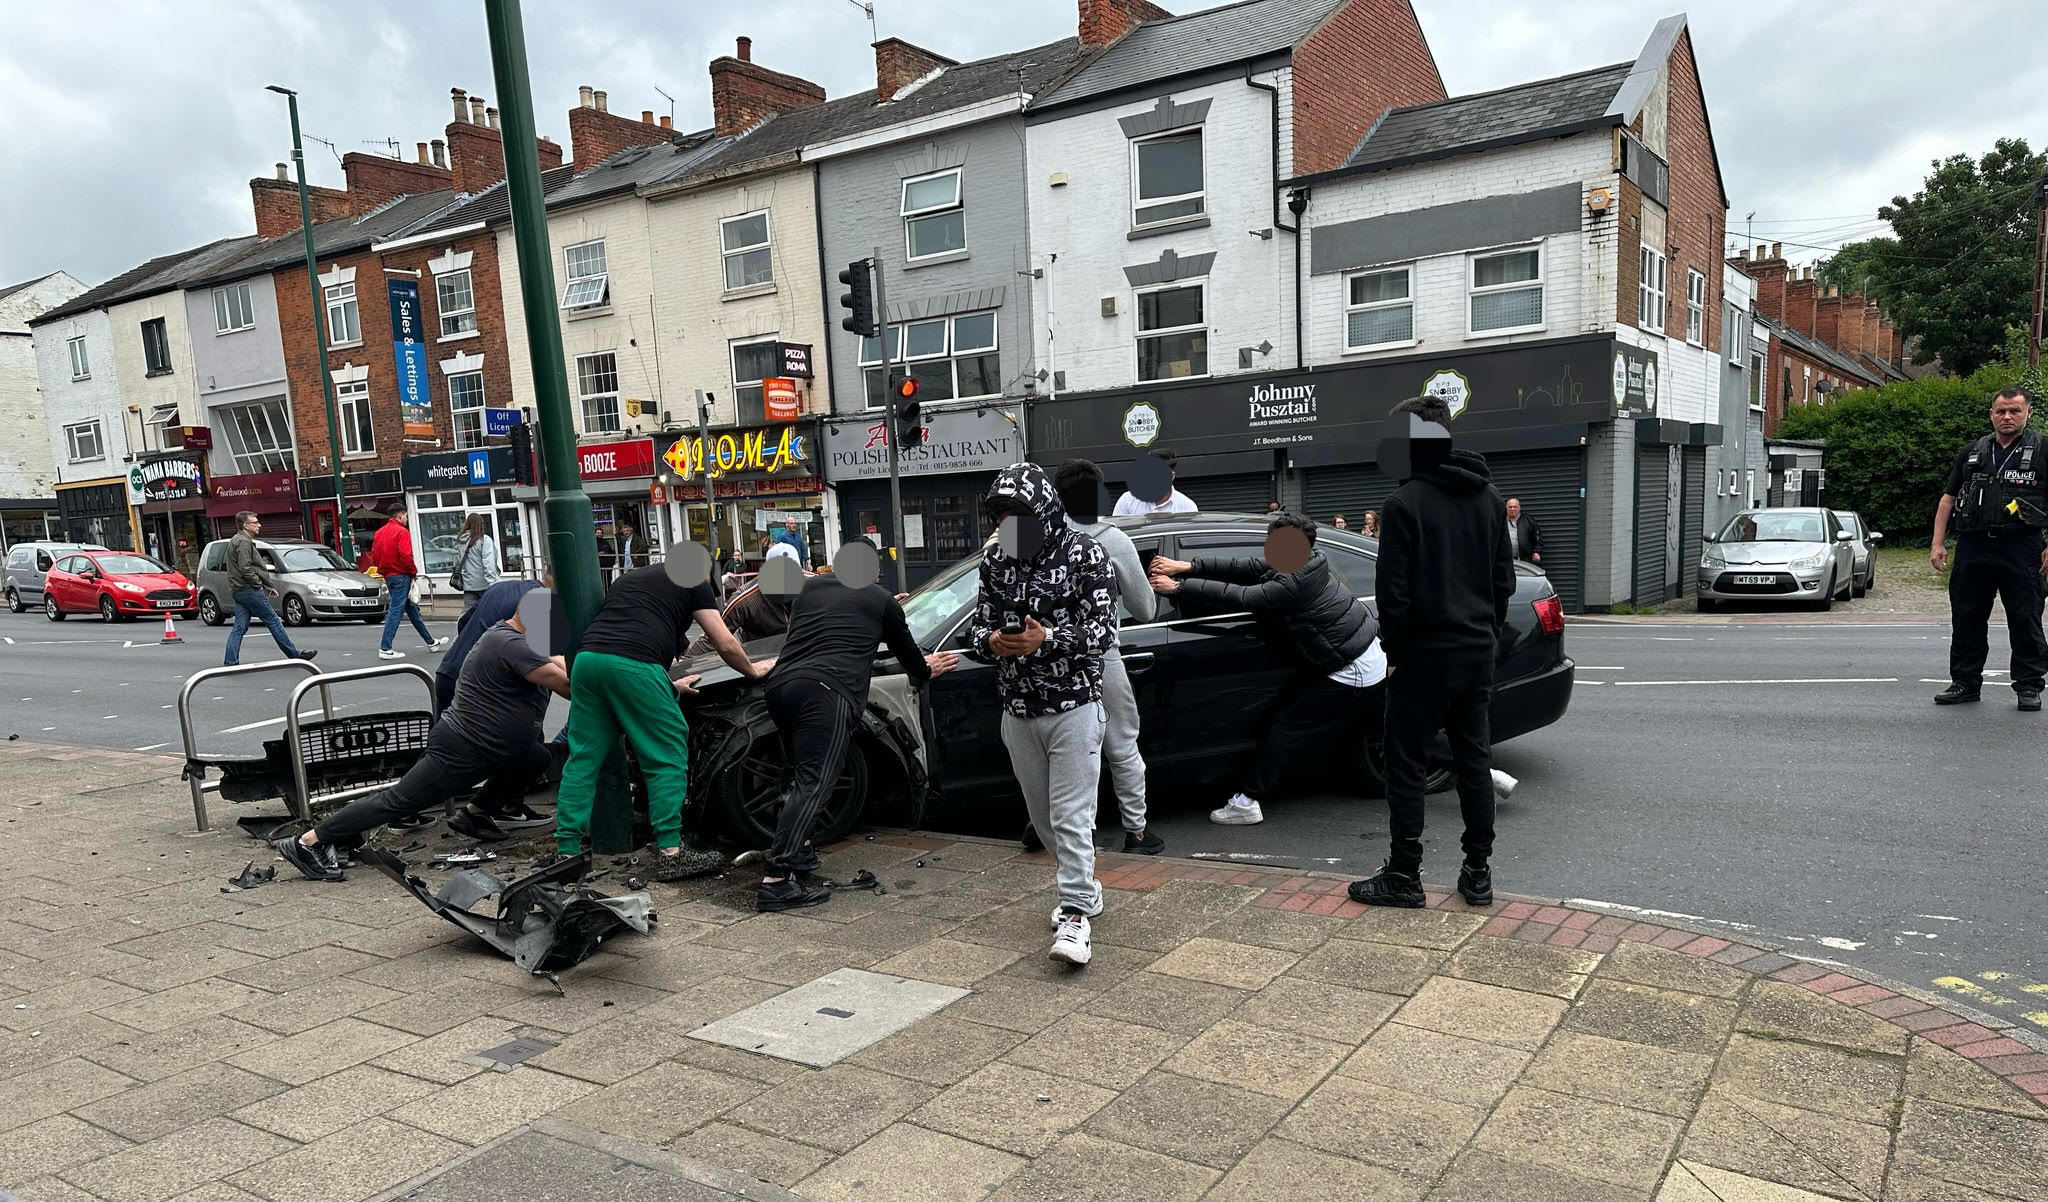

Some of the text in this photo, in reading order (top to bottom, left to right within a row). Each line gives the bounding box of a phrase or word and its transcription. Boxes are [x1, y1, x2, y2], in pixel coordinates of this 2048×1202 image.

[400, 301, 412, 334] Sales
[404, 337, 414, 347] &
[785, 348, 806, 359] PIZZA
[786, 361, 807, 372] ROMA
[405, 351, 419, 401] Lettings
[1249, 383, 1316, 403] Johnny
[1249, 401, 1310, 419] Pusztai
[496, 412, 509, 421] Off
[1128, 418, 1153, 426] SNOBBY
[1293, 415, 1318, 423] BUTCHER
[489, 423, 513, 431] Licen
[1127, 425, 1155, 433] BUTCHER
[1262, 436, 1291, 444] Beedham
[691, 427, 793, 479] ROMA
[833, 438, 1010, 467] POLISH RESTAURANT
[584, 452, 617, 473] BOOZE
[858, 465, 875, 475] Fully
[933, 461, 967, 469] 0115-9858
[140, 460, 196, 484] TWANA BARBERS
[427, 465, 468, 479] whitegates
[2006, 471, 2033, 479] POLICE
[131, 475, 142, 484] OCS
